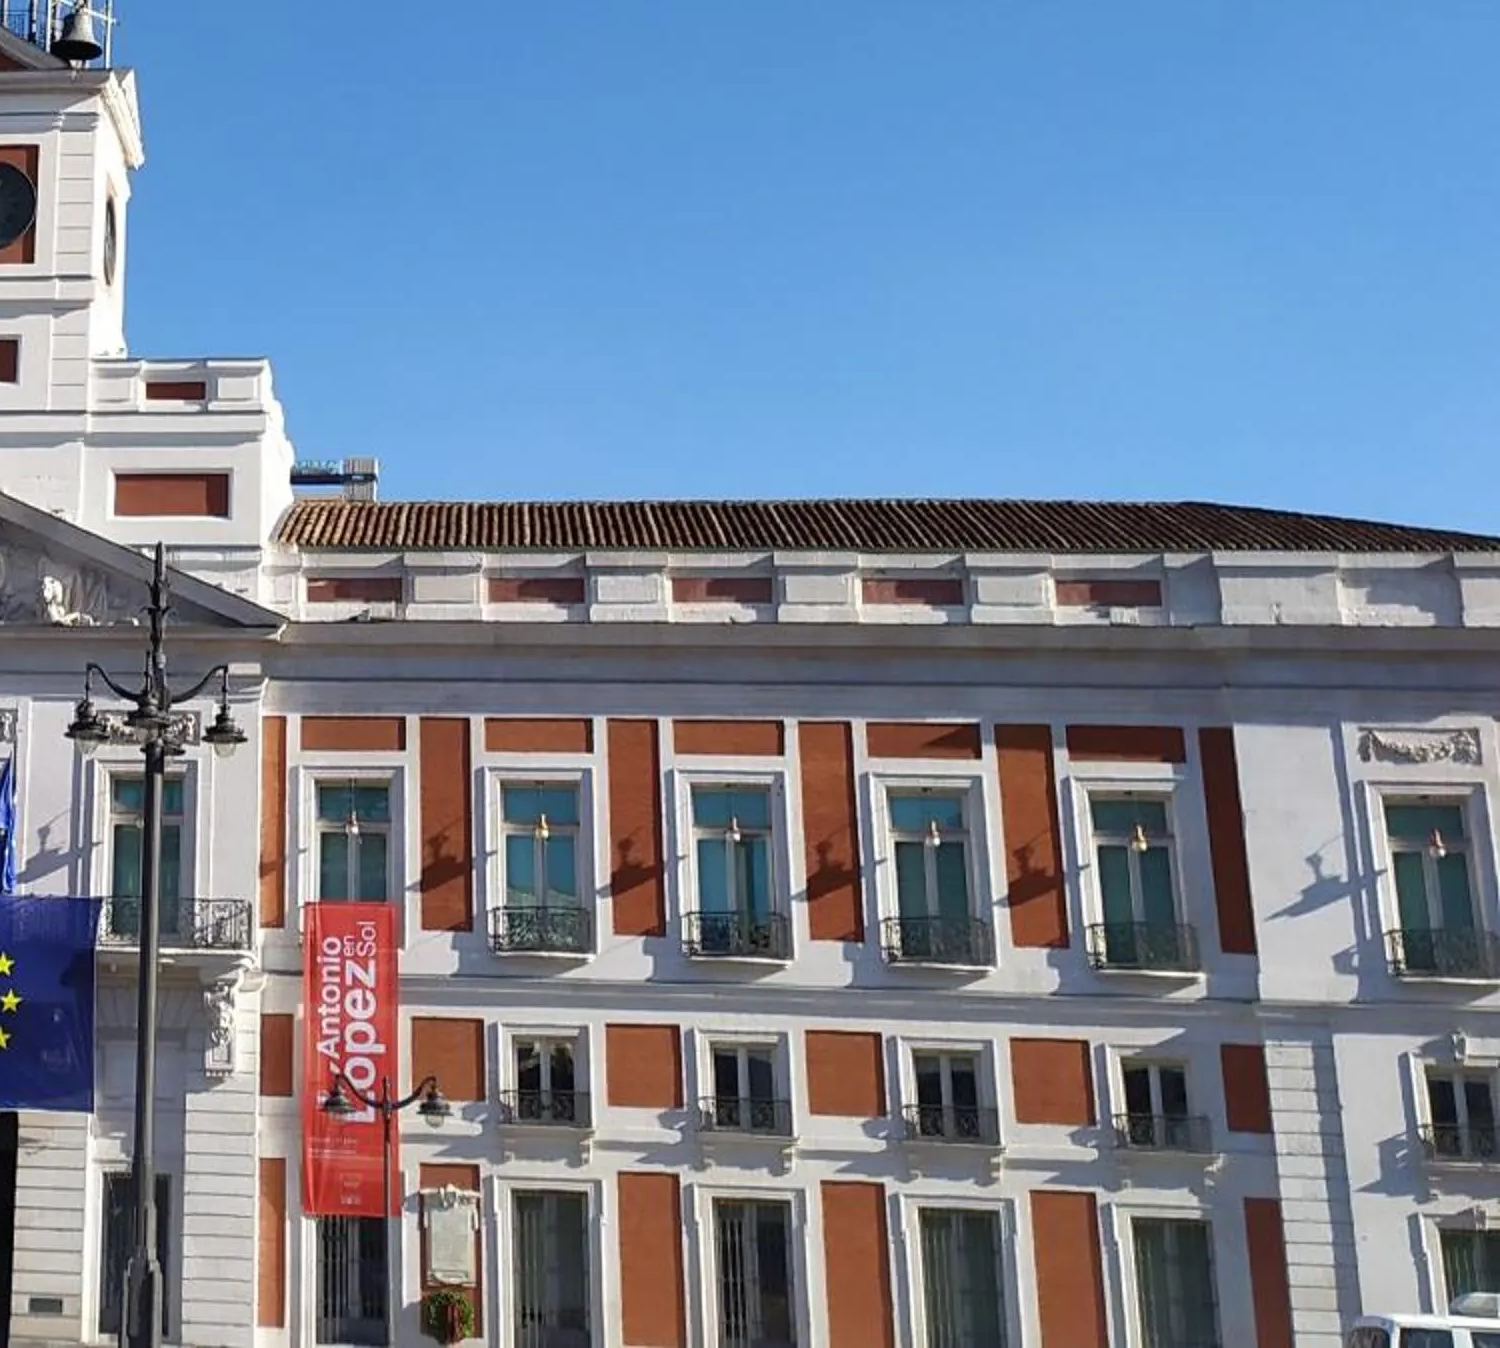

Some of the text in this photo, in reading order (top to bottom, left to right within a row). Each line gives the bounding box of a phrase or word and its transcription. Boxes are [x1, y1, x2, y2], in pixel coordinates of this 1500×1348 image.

[343, 935, 356, 957] en
[356, 921, 376, 957] Sol
[316, 936, 341, 1060] Antonio
[329, 959, 387, 1123] López
